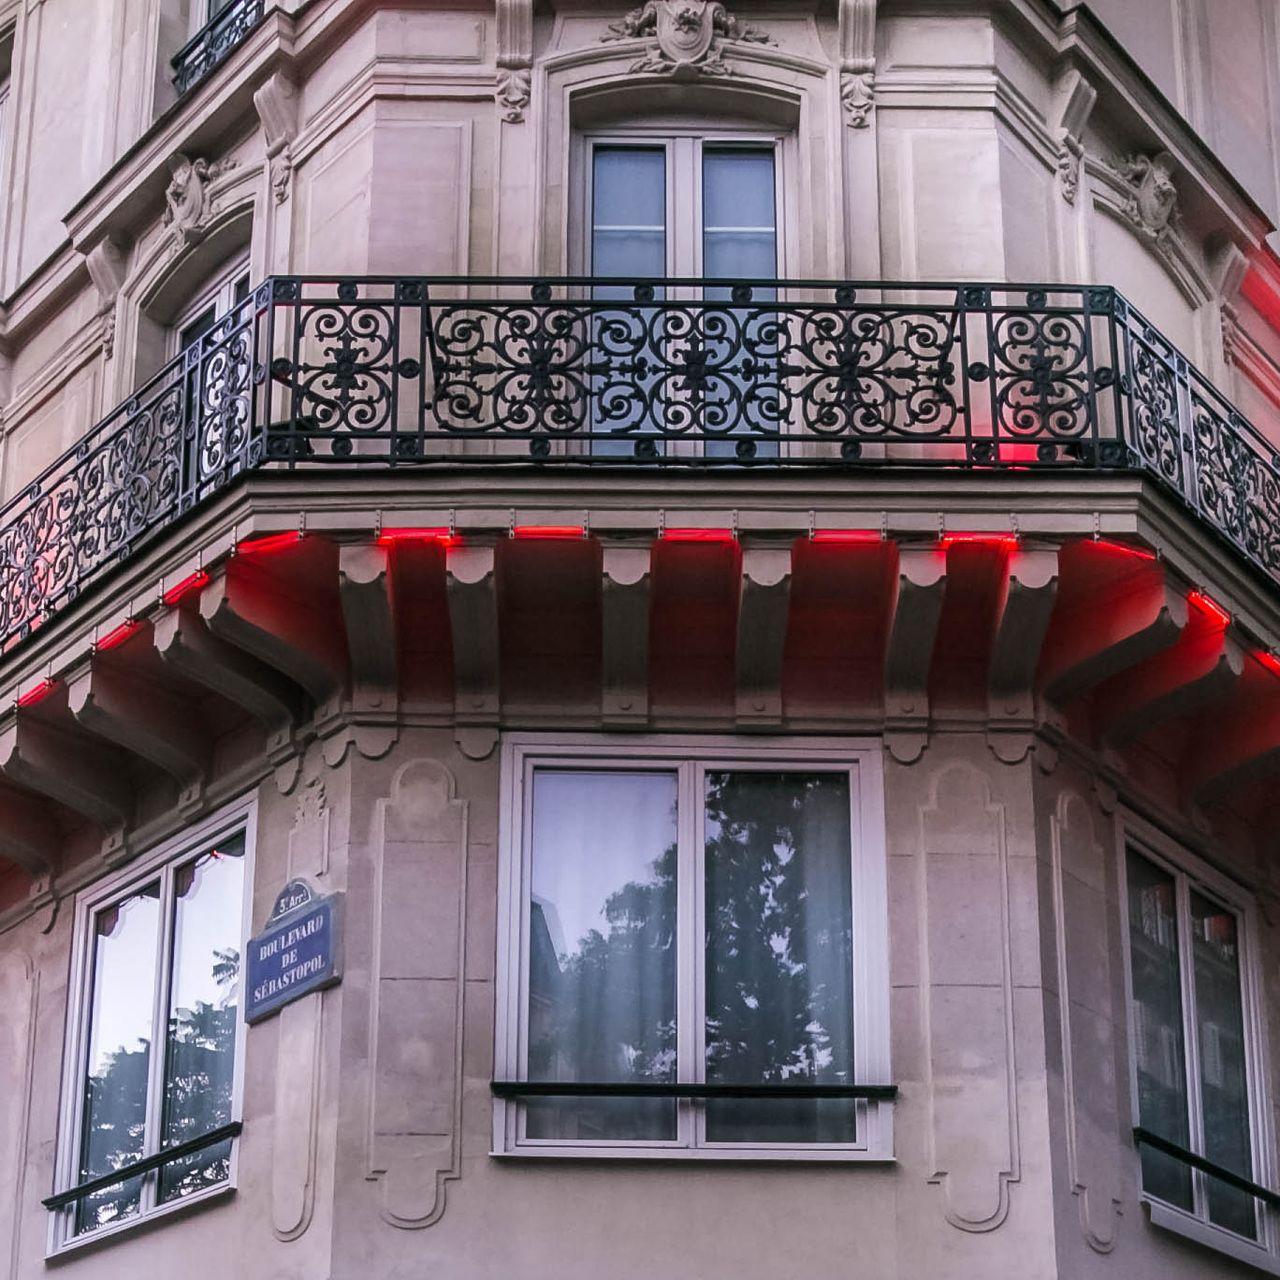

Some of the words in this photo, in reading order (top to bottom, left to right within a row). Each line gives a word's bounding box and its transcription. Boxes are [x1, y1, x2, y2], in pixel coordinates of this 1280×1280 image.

[259, 914, 324, 961] BOULEVARD
[281, 948, 298, 969] DE
[253, 954, 326, 1003] SÉBASTOPOL
